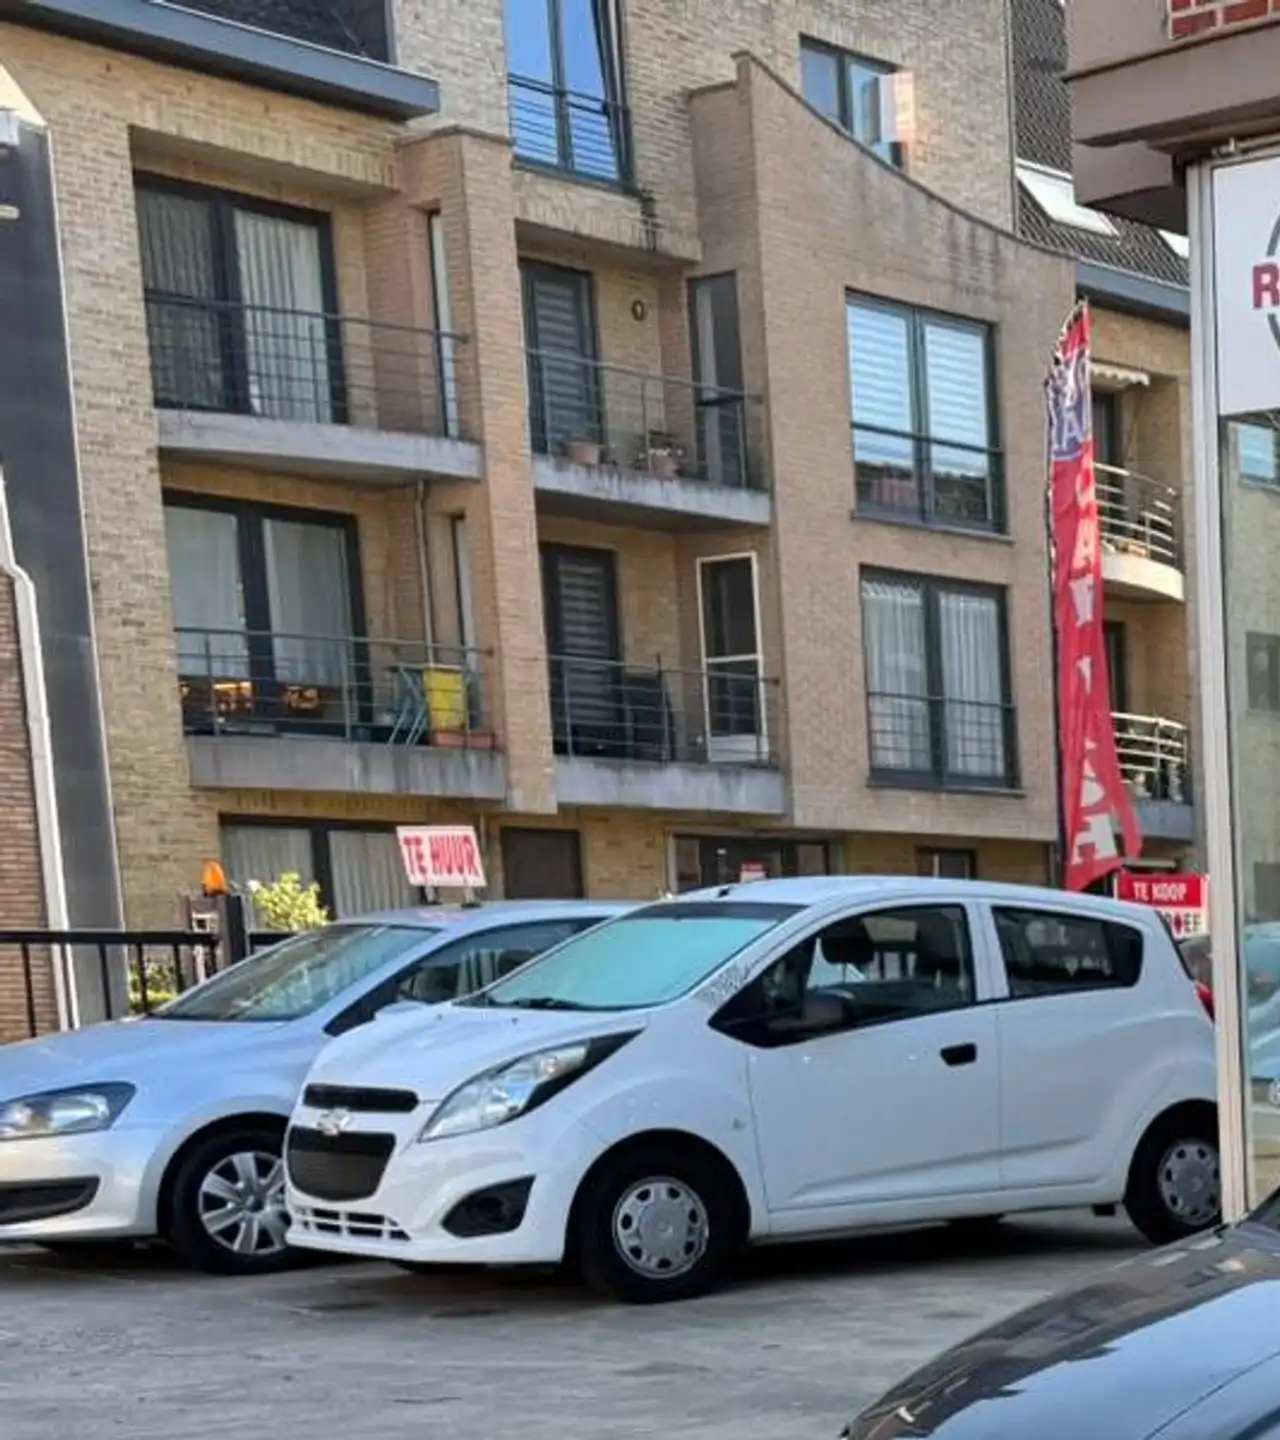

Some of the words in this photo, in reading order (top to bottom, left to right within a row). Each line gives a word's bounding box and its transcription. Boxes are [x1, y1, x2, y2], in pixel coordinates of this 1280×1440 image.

[403, 836, 427, 875] TE
[430, 835, 479, 876] HUUR
[1133, 882, 1149, 902] TE
[1151, 881, 1188, 901] KOOP
